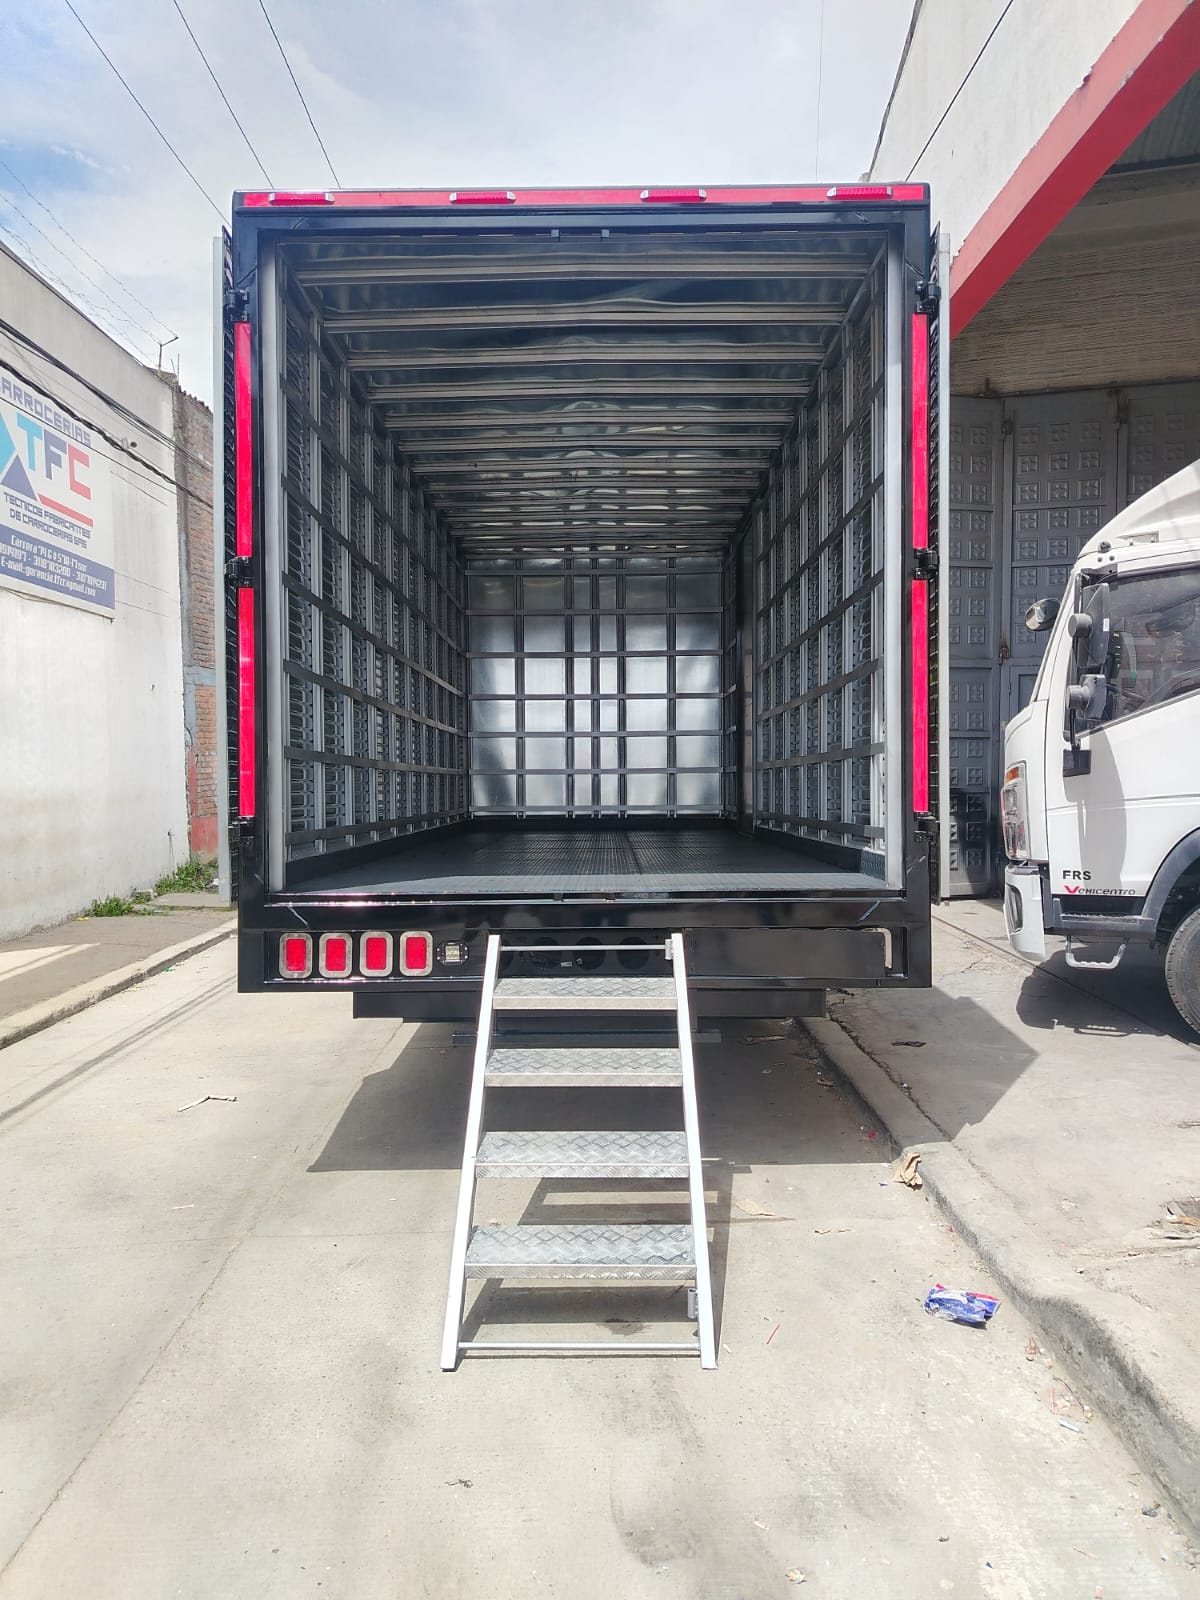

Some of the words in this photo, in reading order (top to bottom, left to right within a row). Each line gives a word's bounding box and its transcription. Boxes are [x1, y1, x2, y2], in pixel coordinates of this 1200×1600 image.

[0, 376, 92, 448] ARROCERIAS
[16, 411, 92, 500] TFC
[10, 508, 21, 521] DE
[1062, 870, 1092, 880] FRS
